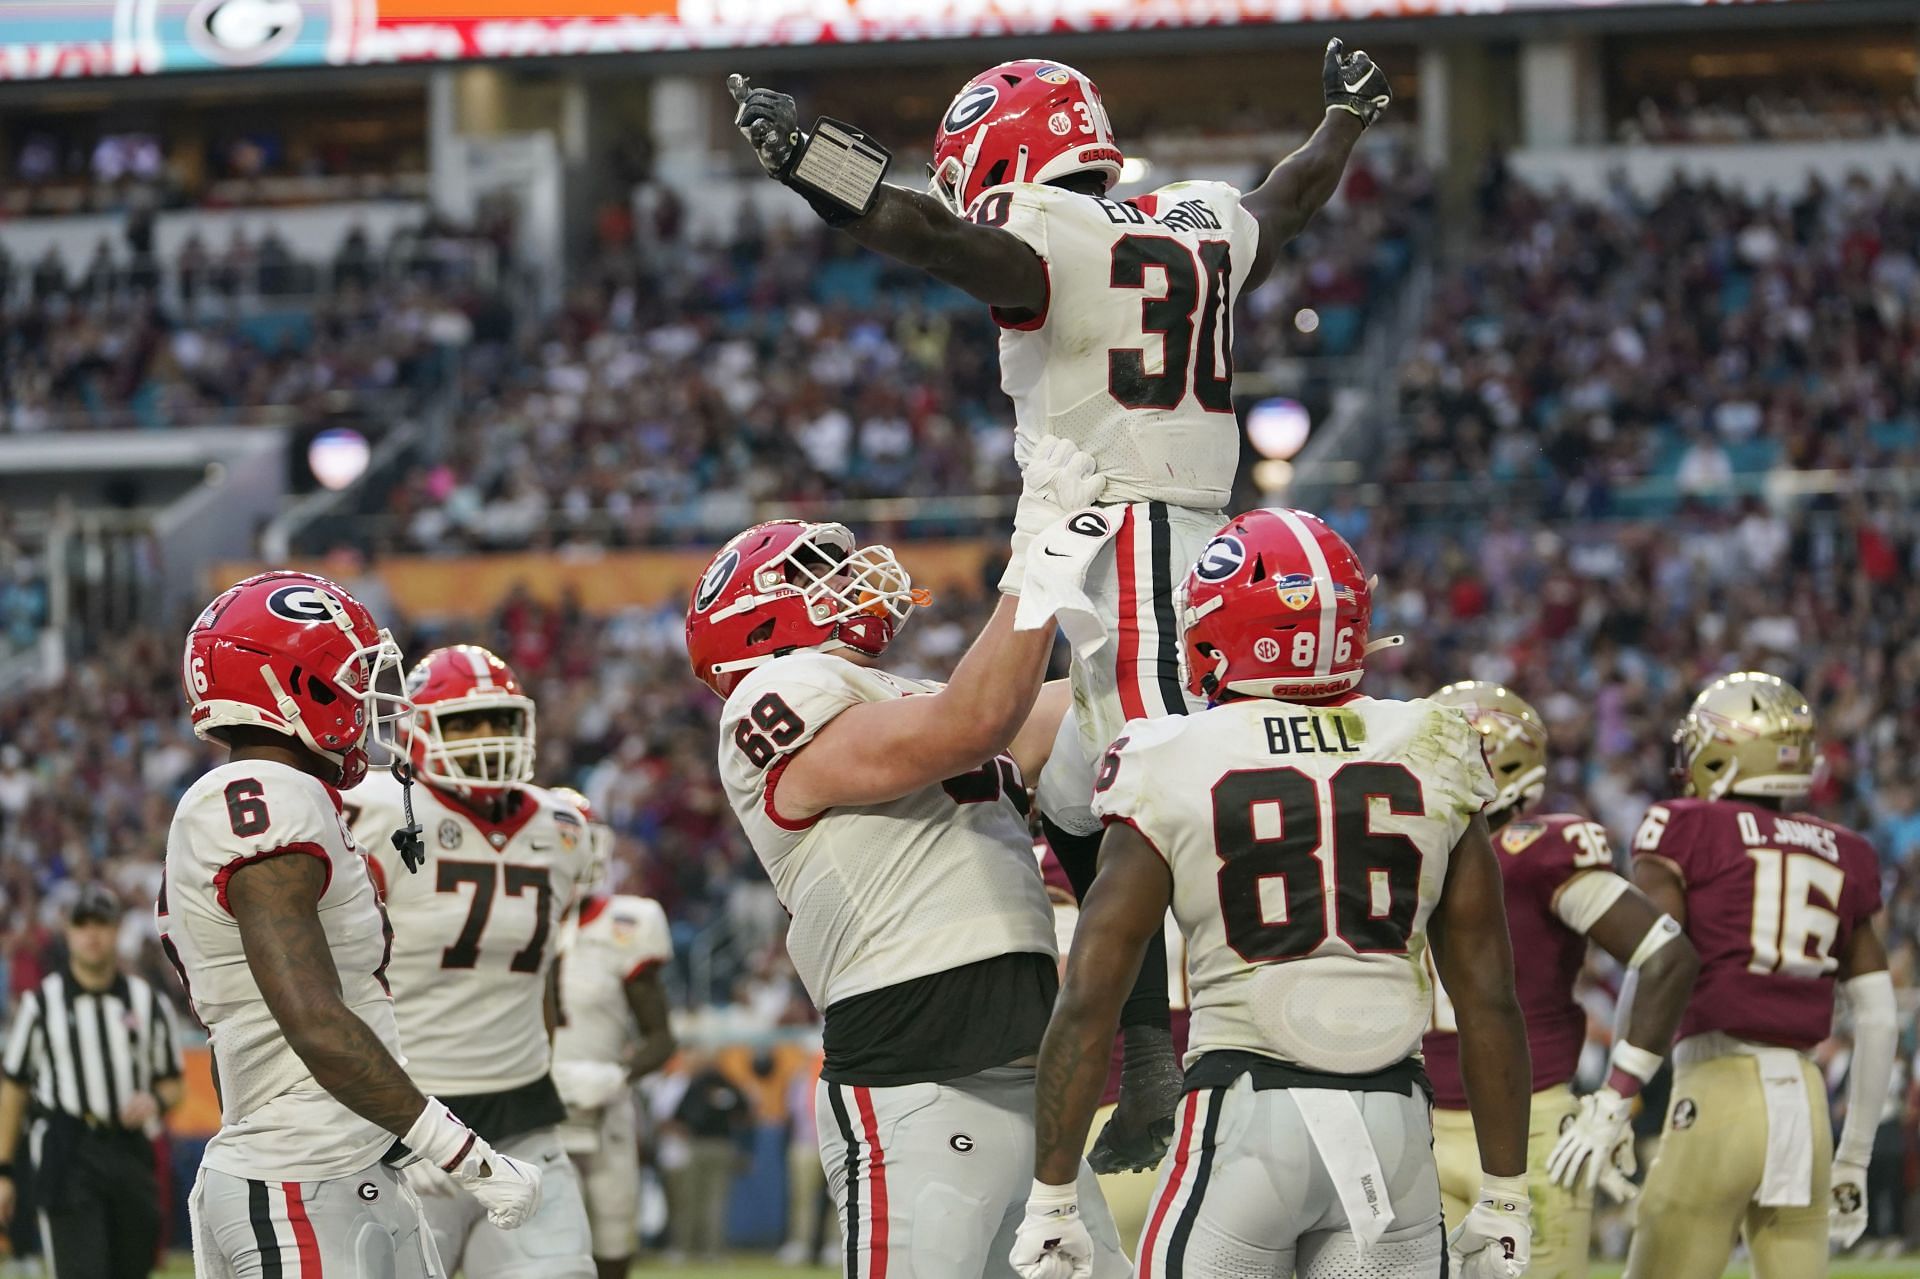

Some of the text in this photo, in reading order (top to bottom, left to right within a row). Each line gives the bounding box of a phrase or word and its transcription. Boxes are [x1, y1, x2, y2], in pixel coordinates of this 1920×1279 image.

[944, 85, 999, 134] G
[1092, 197, 1221, 232] EDARDS
[1108, 233, 1234, 414] 30
[1196, 535, 1246, 583] G
[1256, 641, 1278, 660] SEC
[1291, 628, 1354, 668] 86
[192, 657, 208, 694] 6
[1272, 678, 1351, 696] GEORGIA
[734, 692, 805, 769] 69
[1264, 716, 1360, 754] BELL
[224, 777, 271, 838] 6
[1211, 762, 1425, 963] 86
[1773, 817, 1840, 864] JONES
[435, 860, 552, 974] 77
[1747, 848, 1845, 978] 16
[950, 1133, 974, 1152] G
[358, 1181, 380, 1203] G
